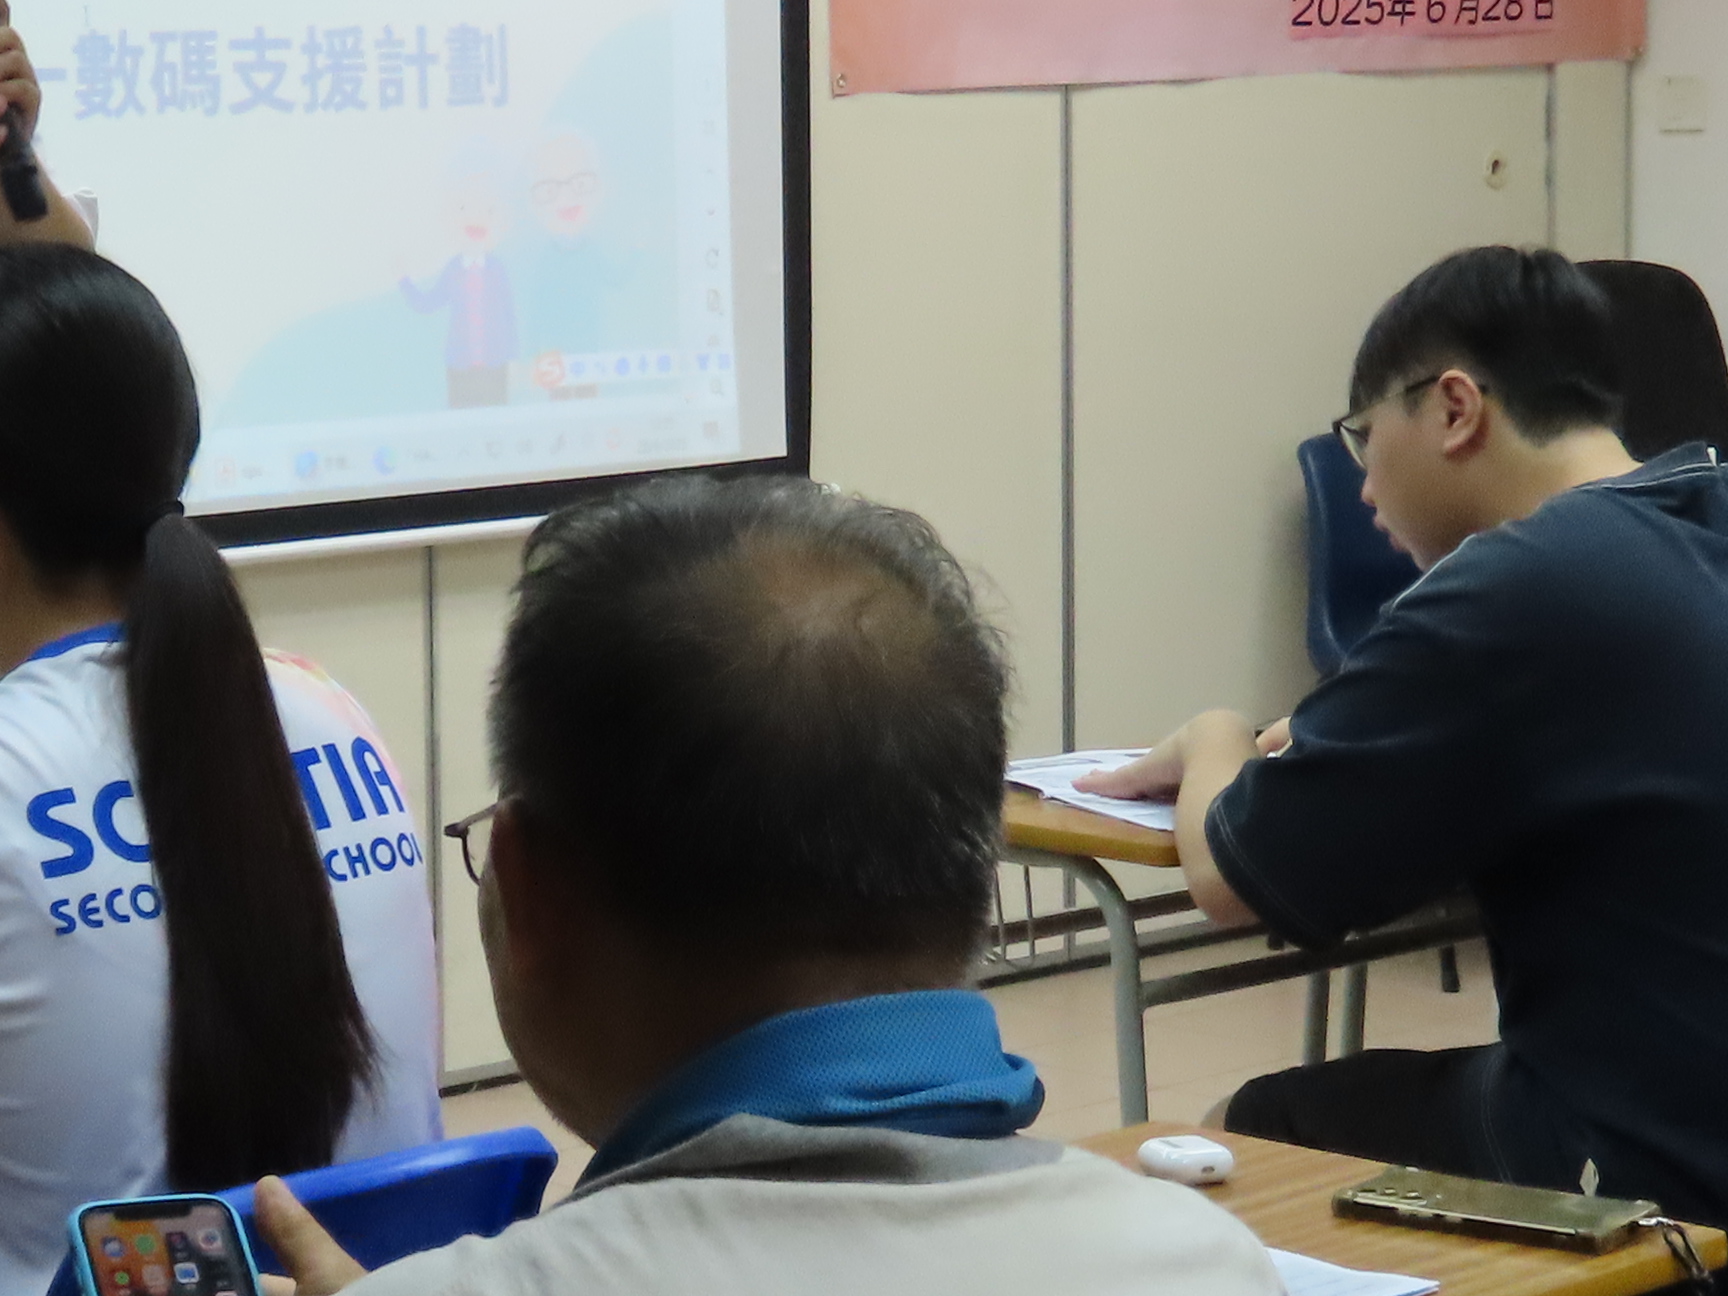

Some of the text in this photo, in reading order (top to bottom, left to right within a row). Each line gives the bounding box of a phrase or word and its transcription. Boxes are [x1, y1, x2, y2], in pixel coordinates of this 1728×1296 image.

[36, 23, 510, 120] 數碼支援計劃
[26, 736, 404, 879] SCTIA
